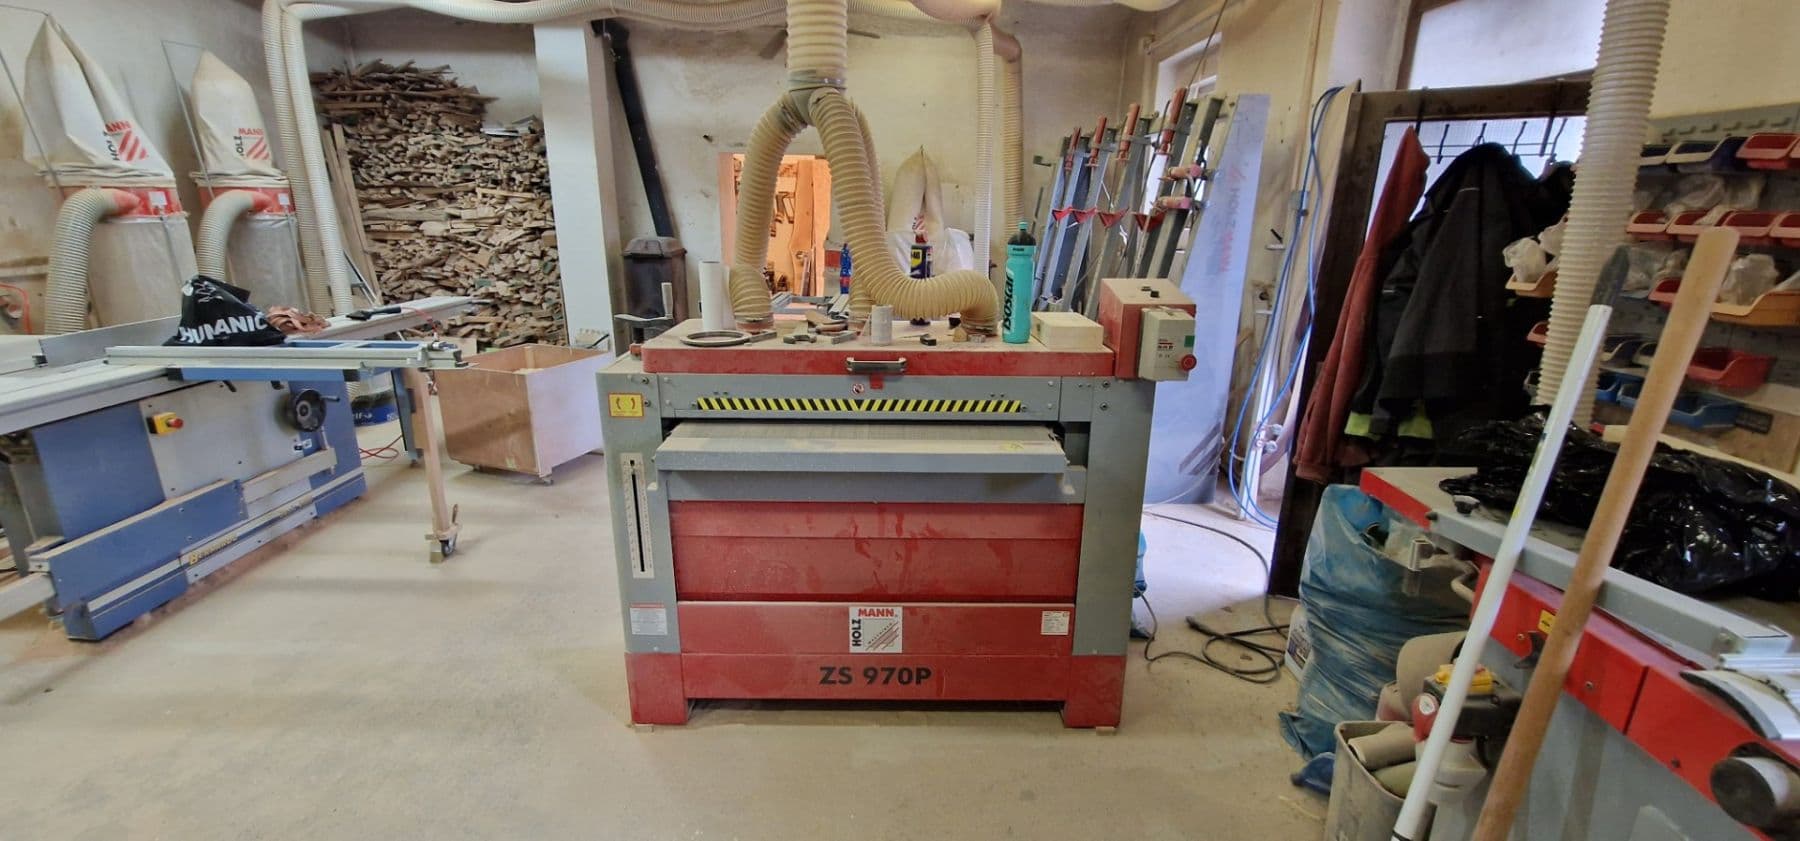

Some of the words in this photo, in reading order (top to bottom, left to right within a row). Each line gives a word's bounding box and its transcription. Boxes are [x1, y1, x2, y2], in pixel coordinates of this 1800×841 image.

[858, 608, 895, 617] MANN
[852, 619, 861, 647] HOLZ
[819, 666, 853, 685] ZS
[863, 666, 932, 685] 970P
